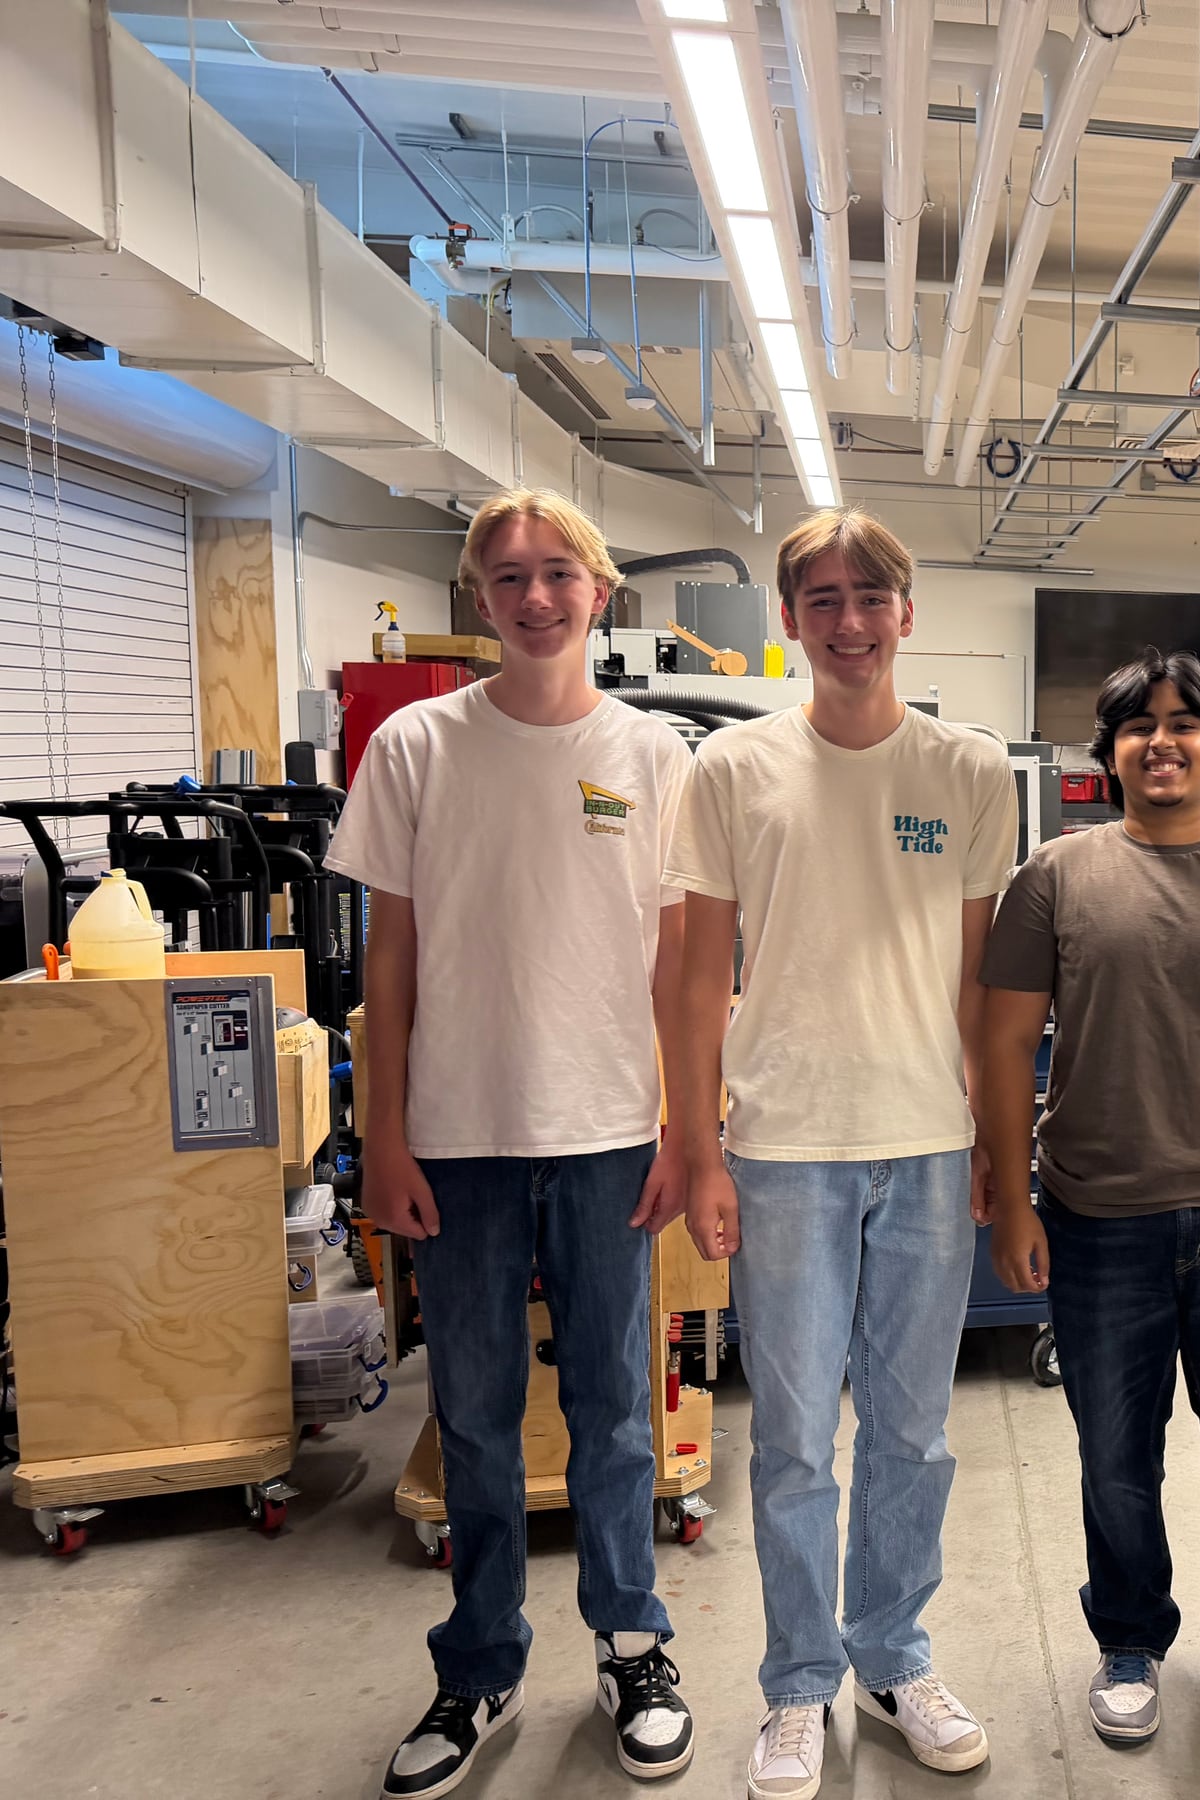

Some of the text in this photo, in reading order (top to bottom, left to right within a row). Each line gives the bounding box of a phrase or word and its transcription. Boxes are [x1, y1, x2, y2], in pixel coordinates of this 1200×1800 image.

[586, 806, 625, 816] BURGER
[894, 815, 948, 838] High
[896, 836, 943, 854] Tide
